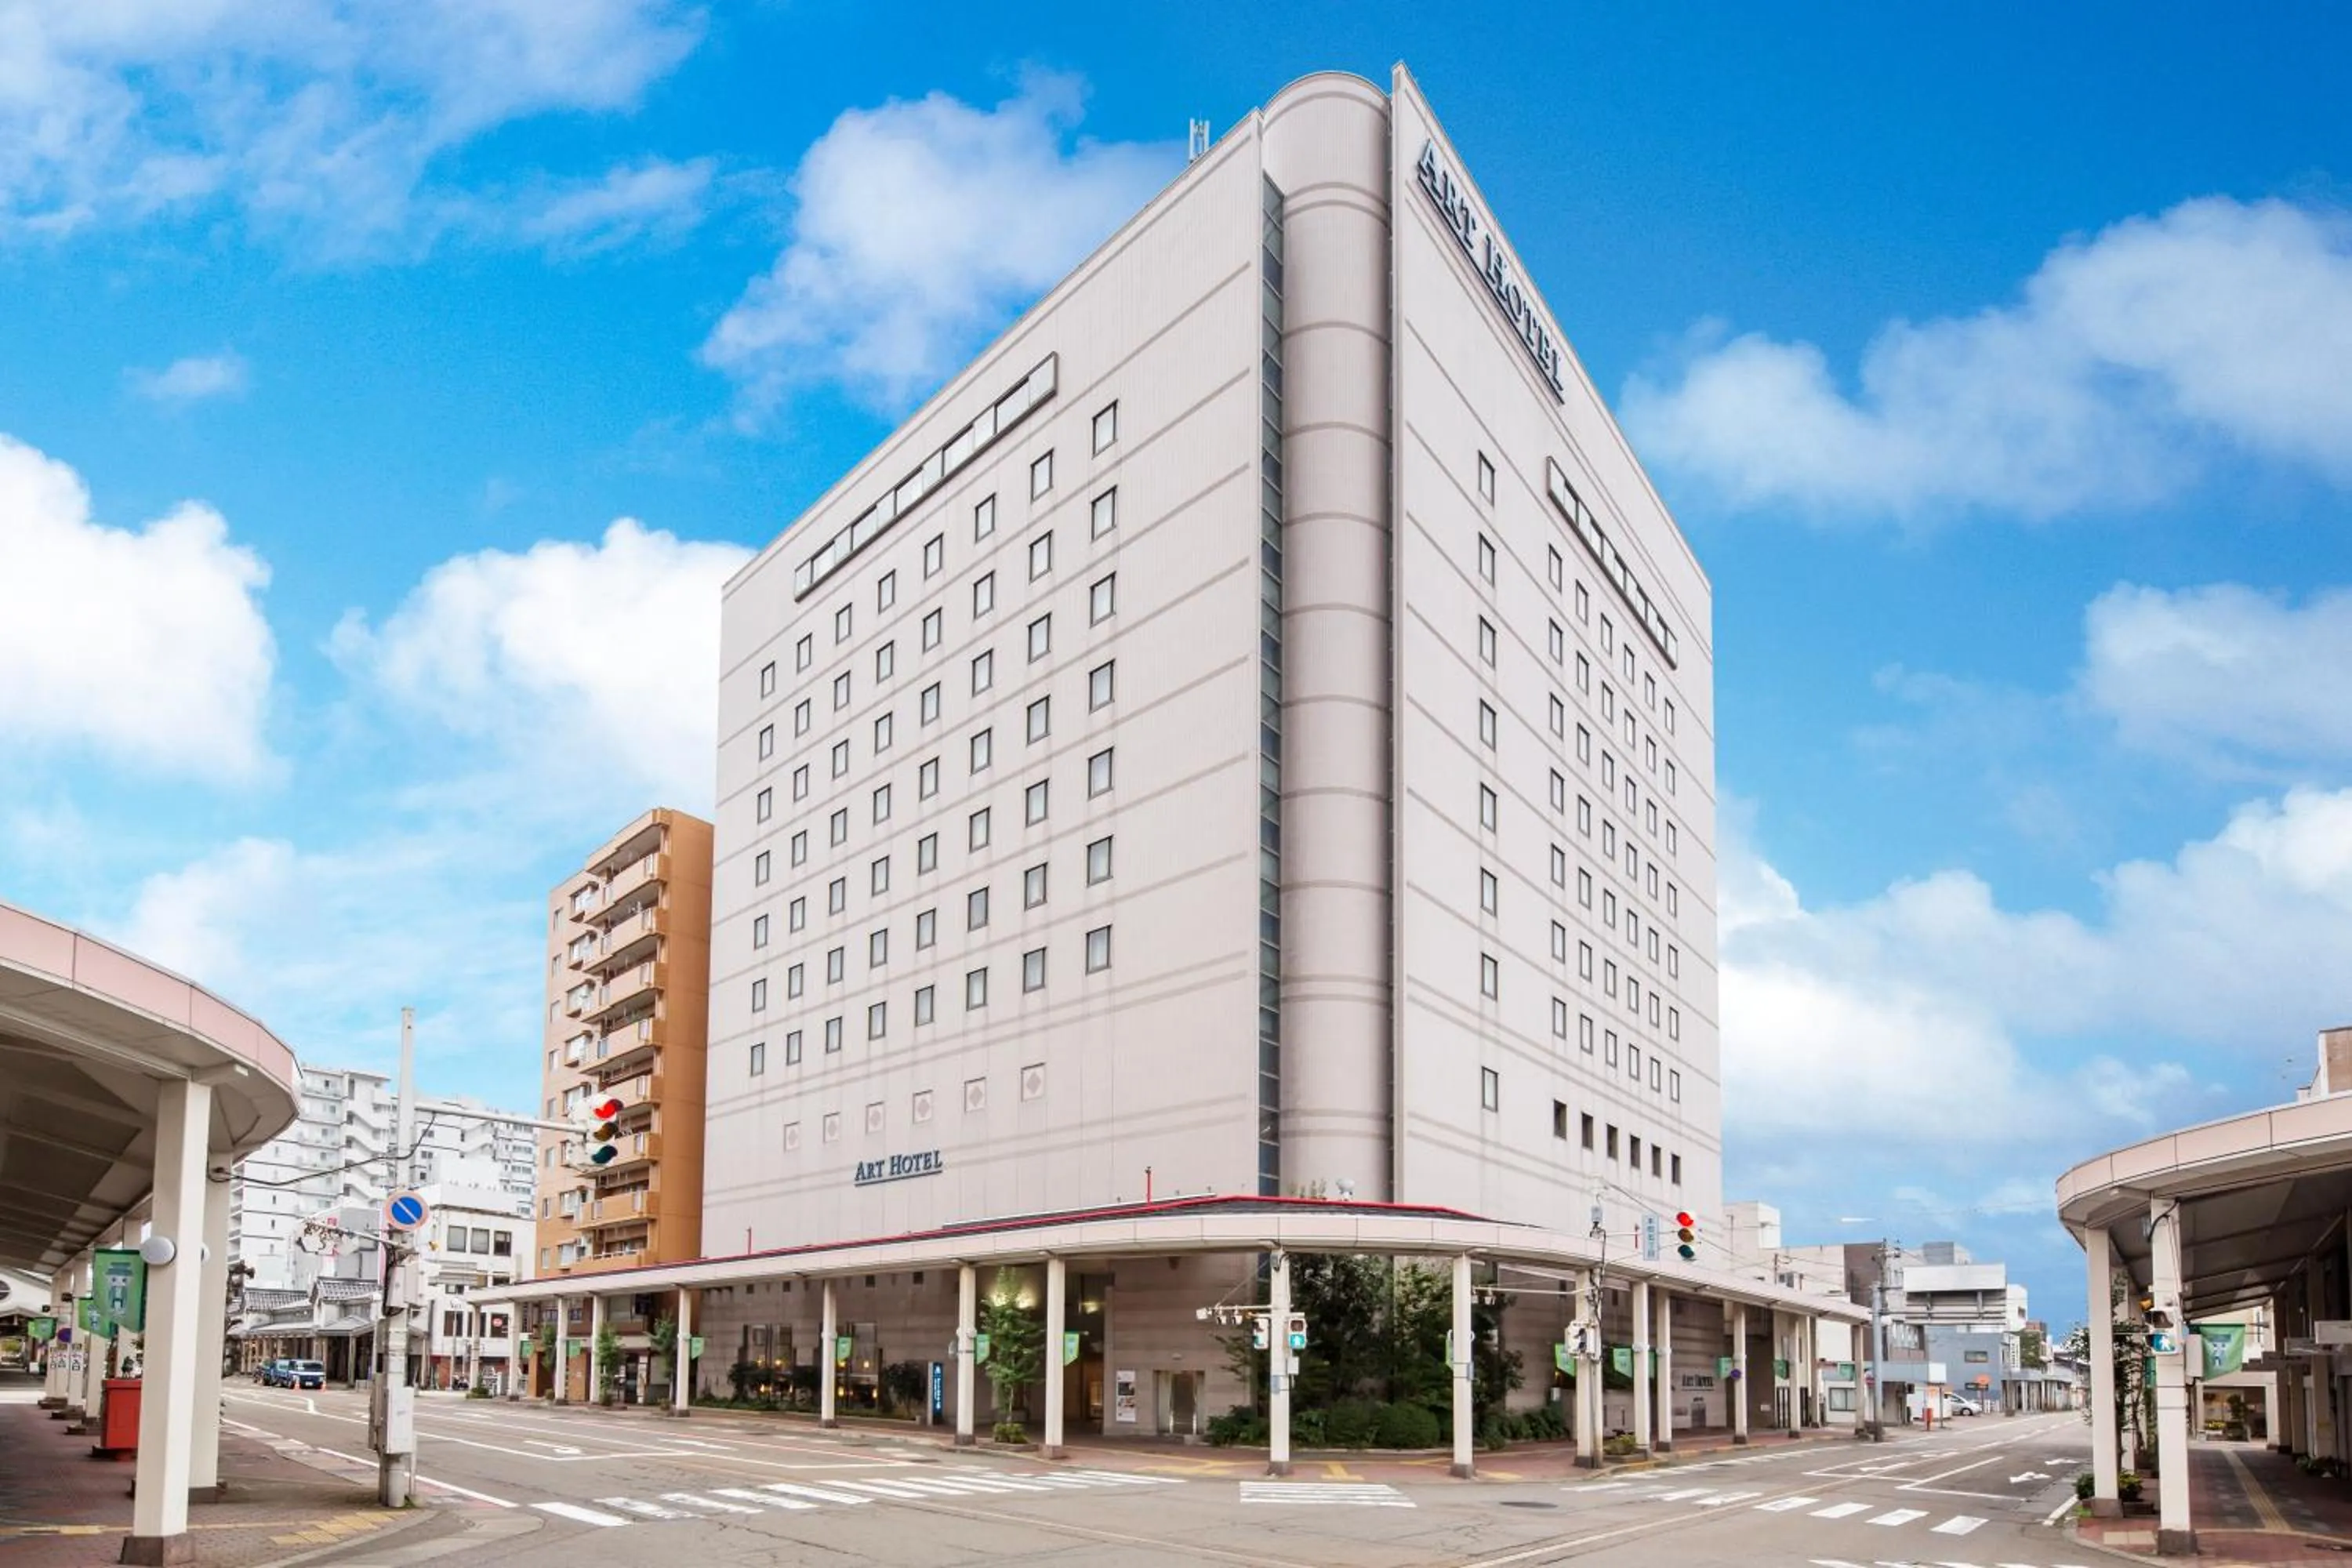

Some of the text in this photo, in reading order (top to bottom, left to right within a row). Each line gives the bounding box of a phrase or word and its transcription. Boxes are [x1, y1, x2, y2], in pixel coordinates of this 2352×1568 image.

[1417, 138, 1564, 391] ART HOTEL
[854, 1150, 943, 1181] ART HOTEL
